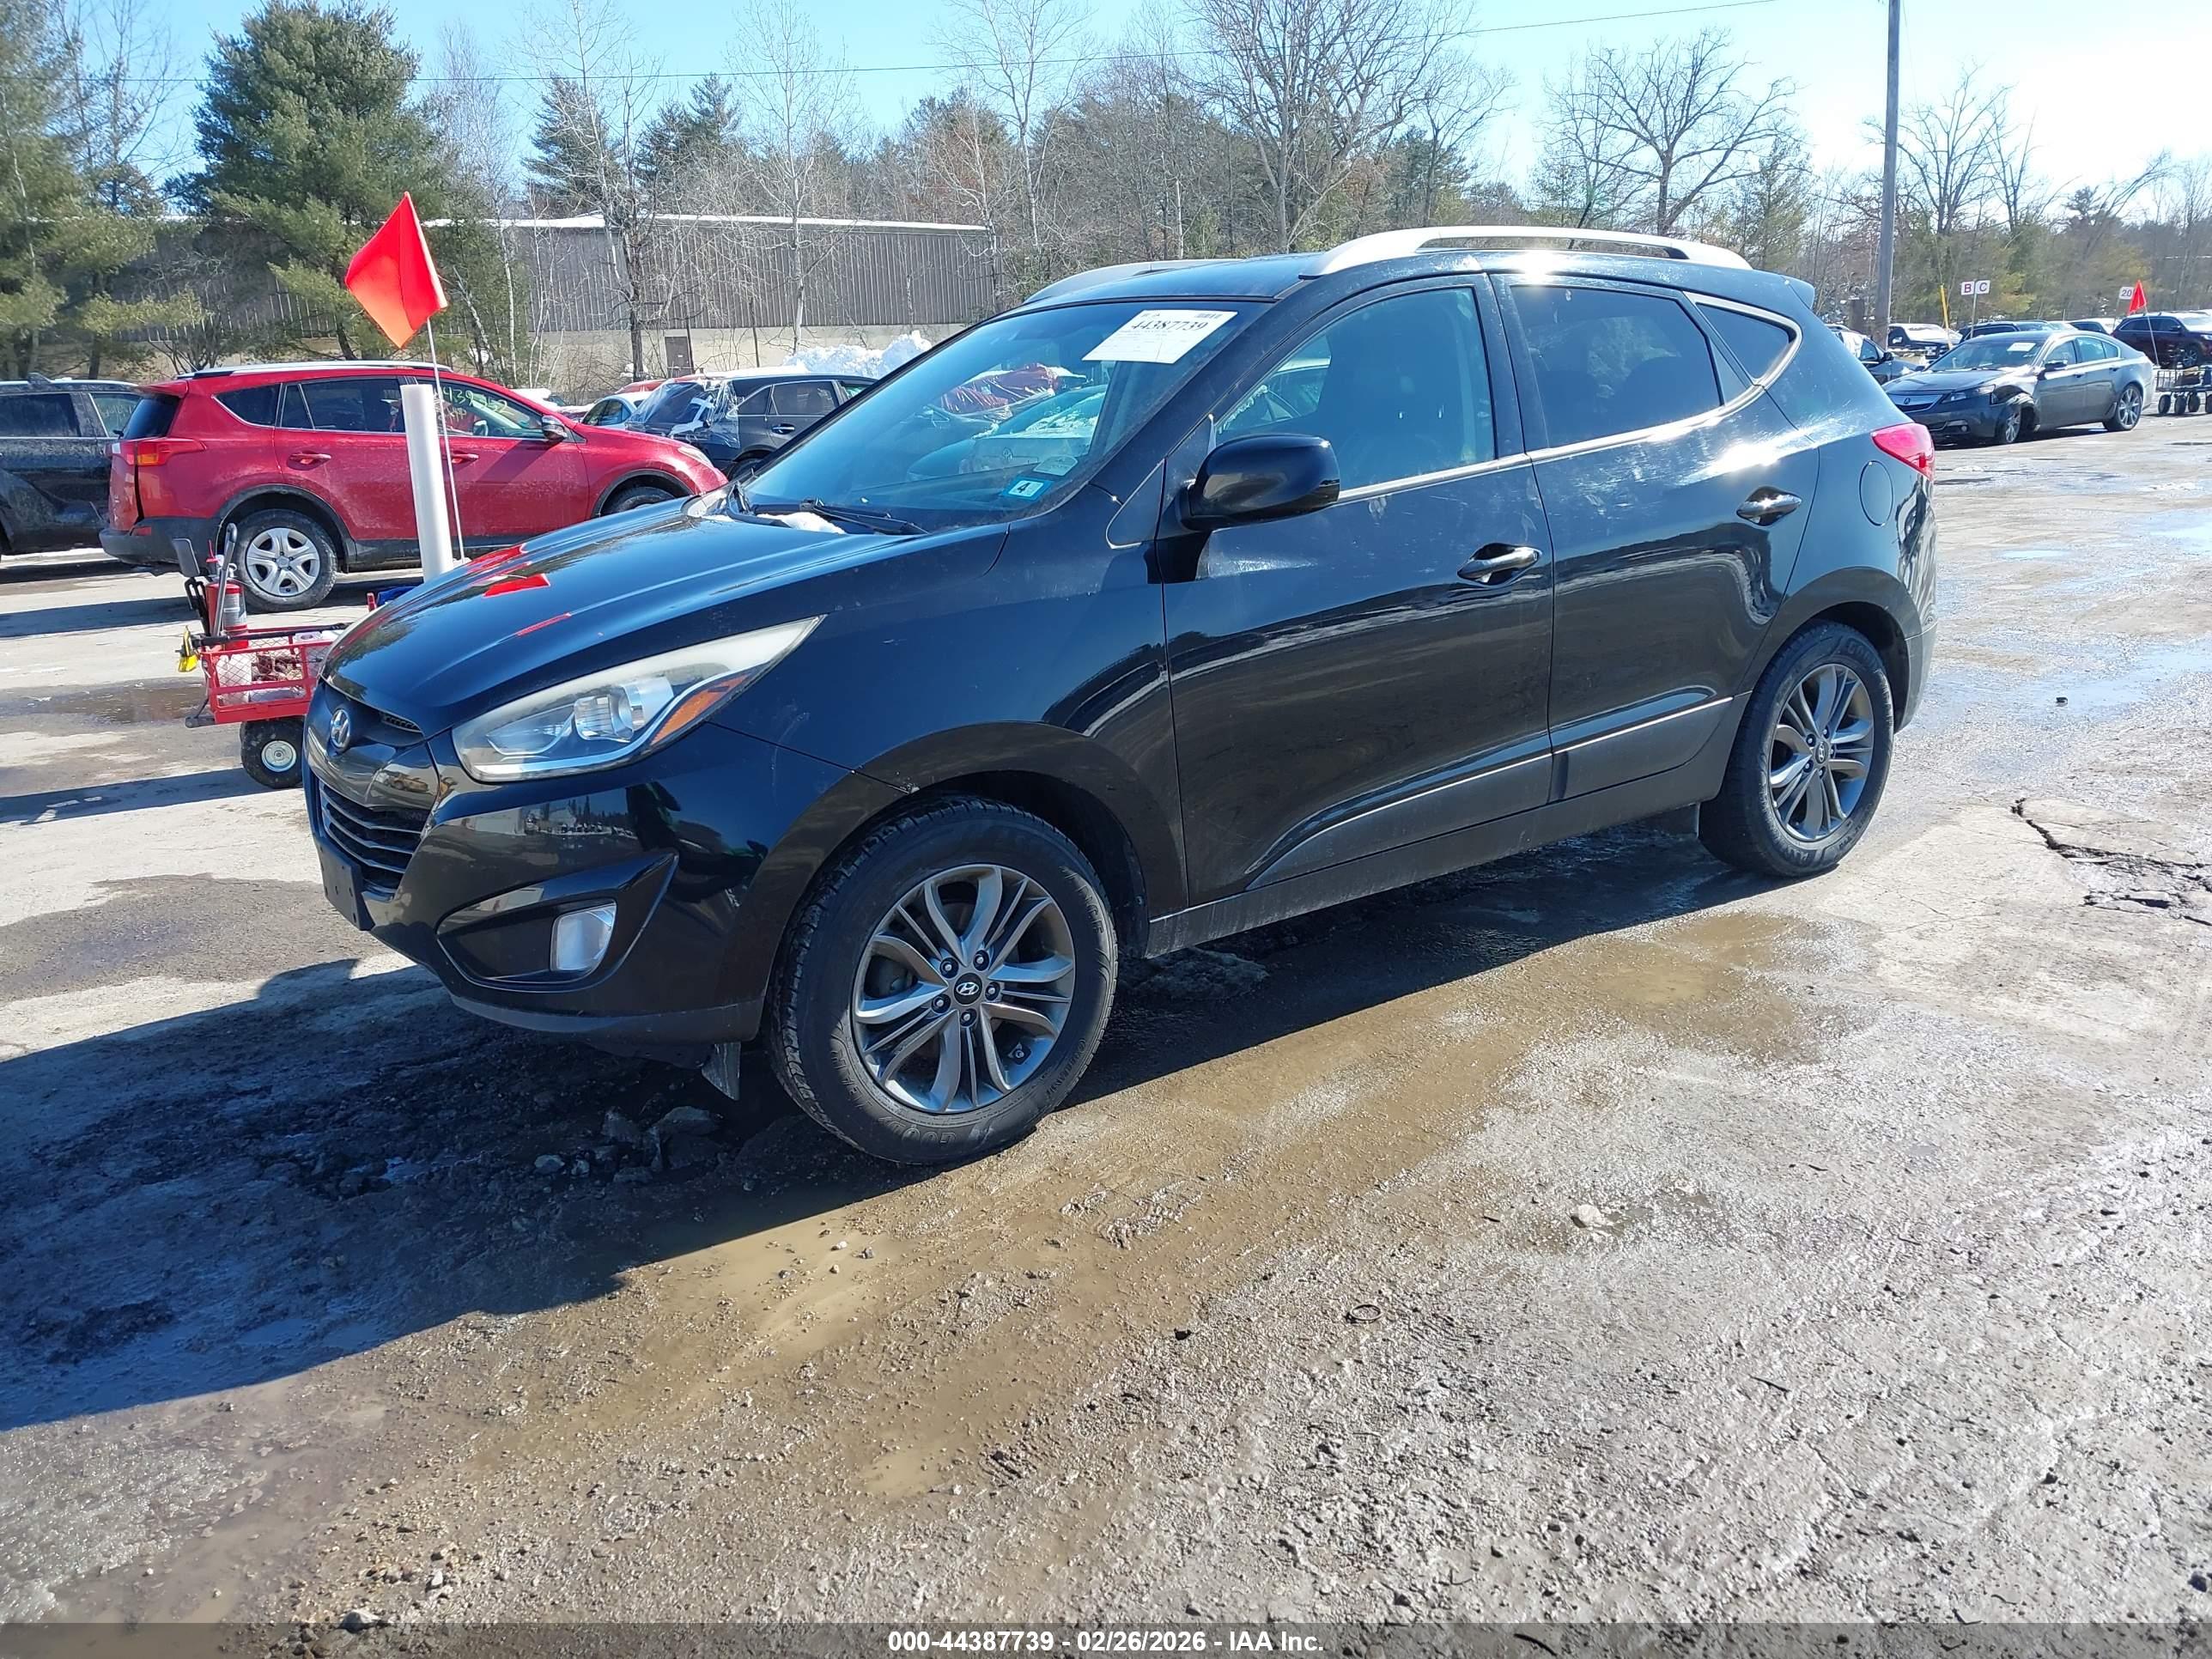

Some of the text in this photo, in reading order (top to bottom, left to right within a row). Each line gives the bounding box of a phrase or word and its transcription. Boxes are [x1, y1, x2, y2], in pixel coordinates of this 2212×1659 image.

[1964, 283, 1972, 293] B
[1978, 282, 1988, 292] C
[2121, 289, 2132, 297] 20
[1132, 320, 1209, 331] 44387739
[1017, 482, 1031, 494] 4
